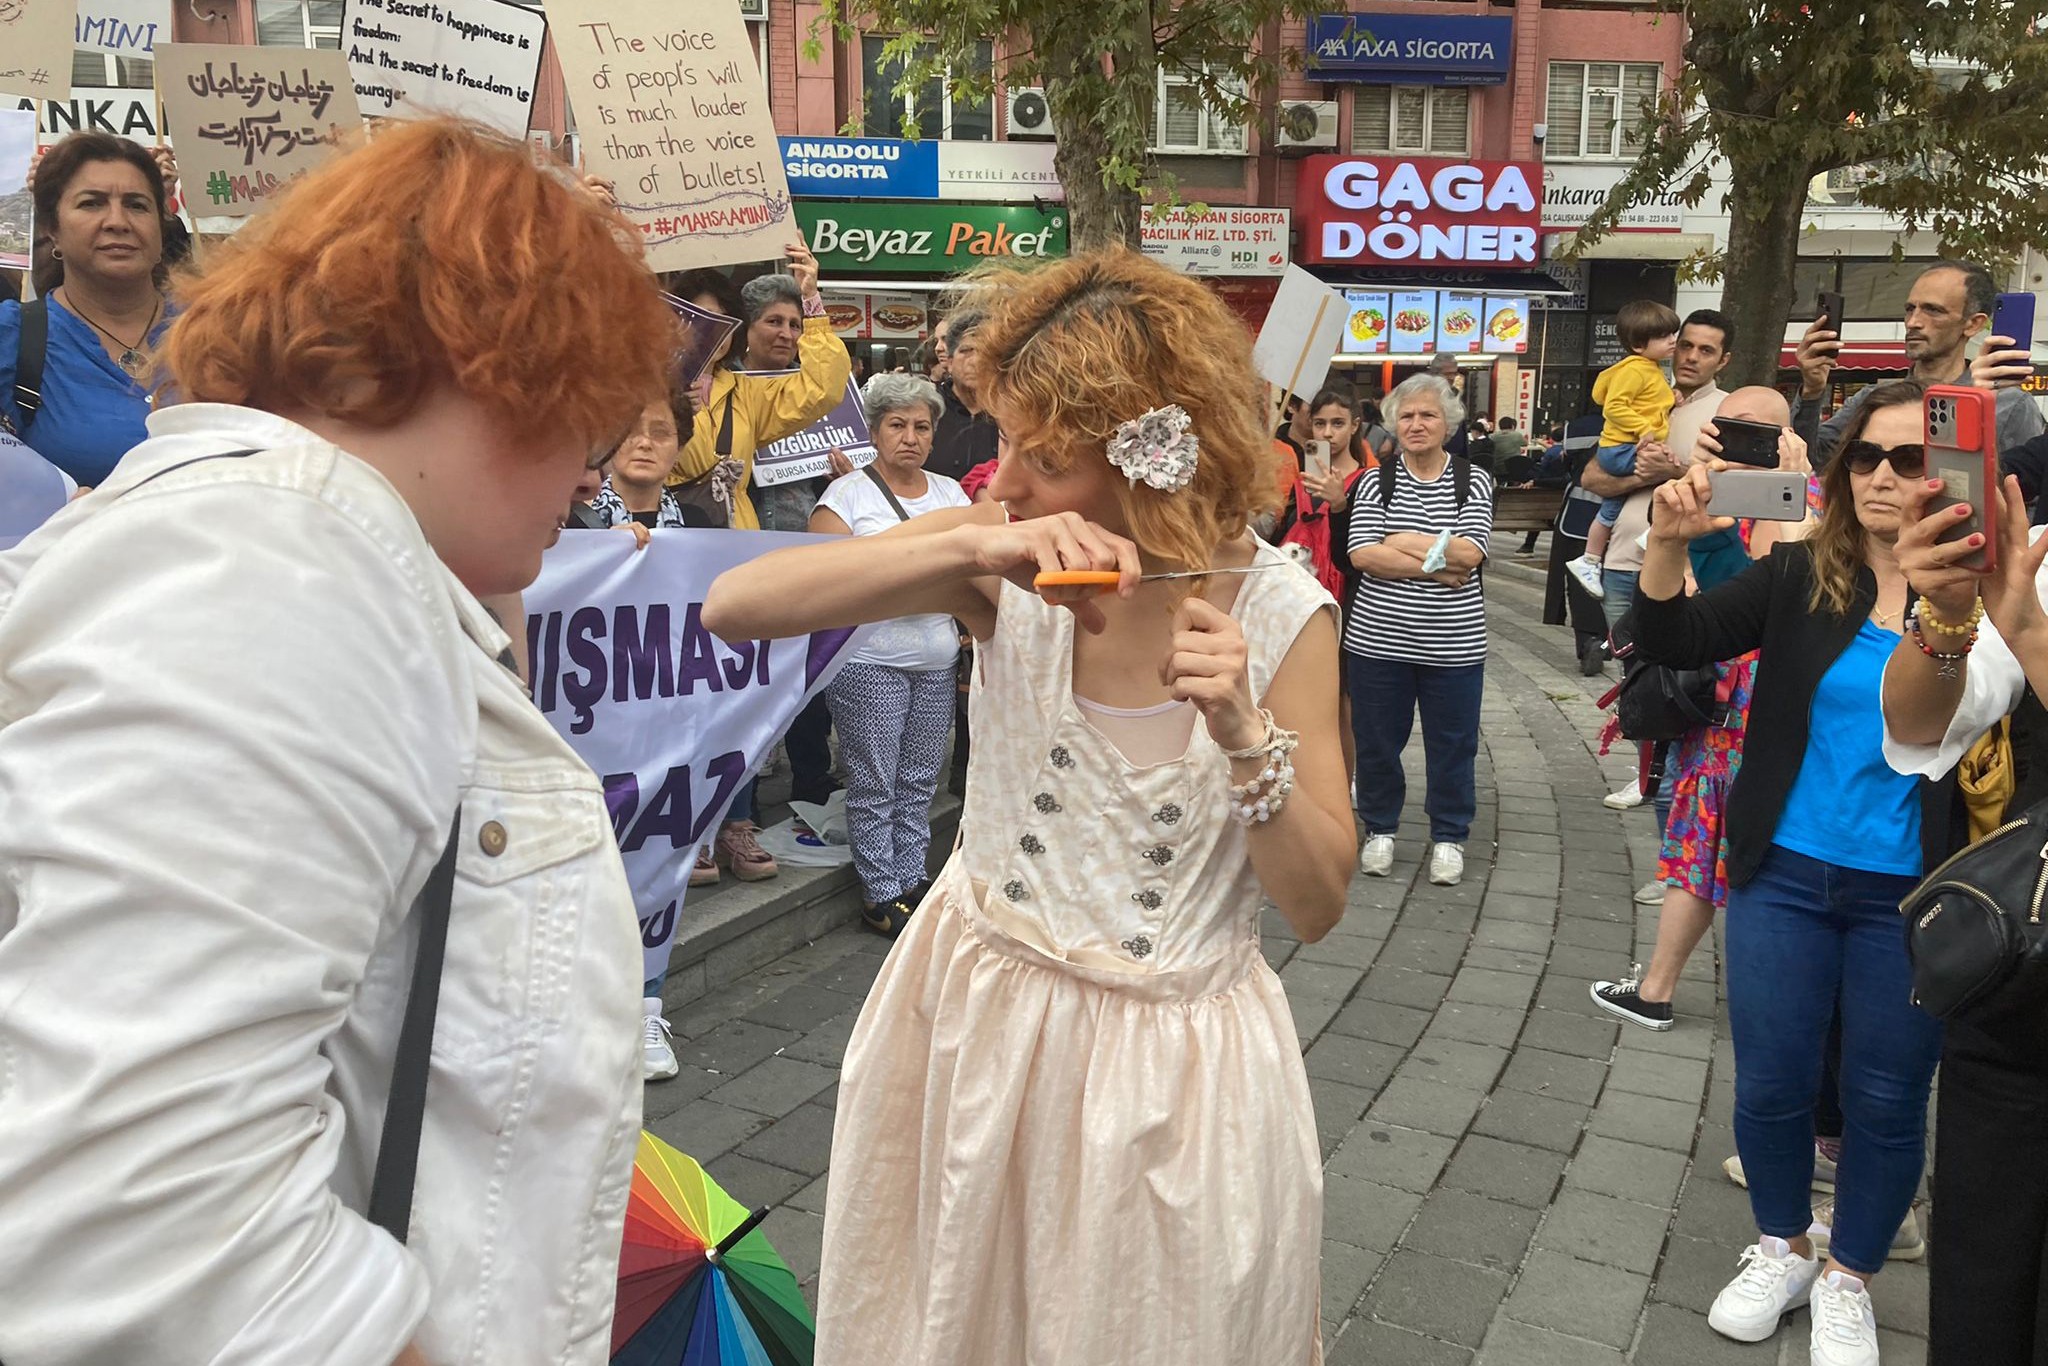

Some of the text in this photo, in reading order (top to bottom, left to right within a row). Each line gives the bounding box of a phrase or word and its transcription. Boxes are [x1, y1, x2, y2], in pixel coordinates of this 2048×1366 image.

[386, 0, 430, 18] secret
[431, 4, 444, 23] to
[446, 11, 514, 44] happiness
[518, 35, 530, 49] is
[578, 22, 716, 55] The voice
[1354, 38, 1495, 60] AXA SİGORTA
[348, 44, 530, 103] And the secret to freedom is
[592, 60, 743, 102] of peopl's will
[17, 98, 169, 136] NKA
[598, 93, 748, 125] is much louder
[602, 126, 756, 161] than the voice
[786, 143, 900, 161] ANADOLU
[638, 161, 766, 194] of bullets!
[786, 158, 888, 179] SİGORTA
[948, 169, 1058, 182] YETKİLİ ACENT
[1323, 160, 1536, 213] GAGA
[1627, 186, 1684, 209] gorta
[1231, 210, 1285, 224] SİGORTA
[811, 218, 1054, 263] Beyaz Paket
[1141, 226, 1277, 244] RACILIK HİZ. LTD. ŞTİ.
[1181, 246, 1210, 255] Allianz
[1321, 210, 1537, 263] DÖNER
[1231, 251, 1258, 262] HDI
[775, 464, 807, 479] BURSA
